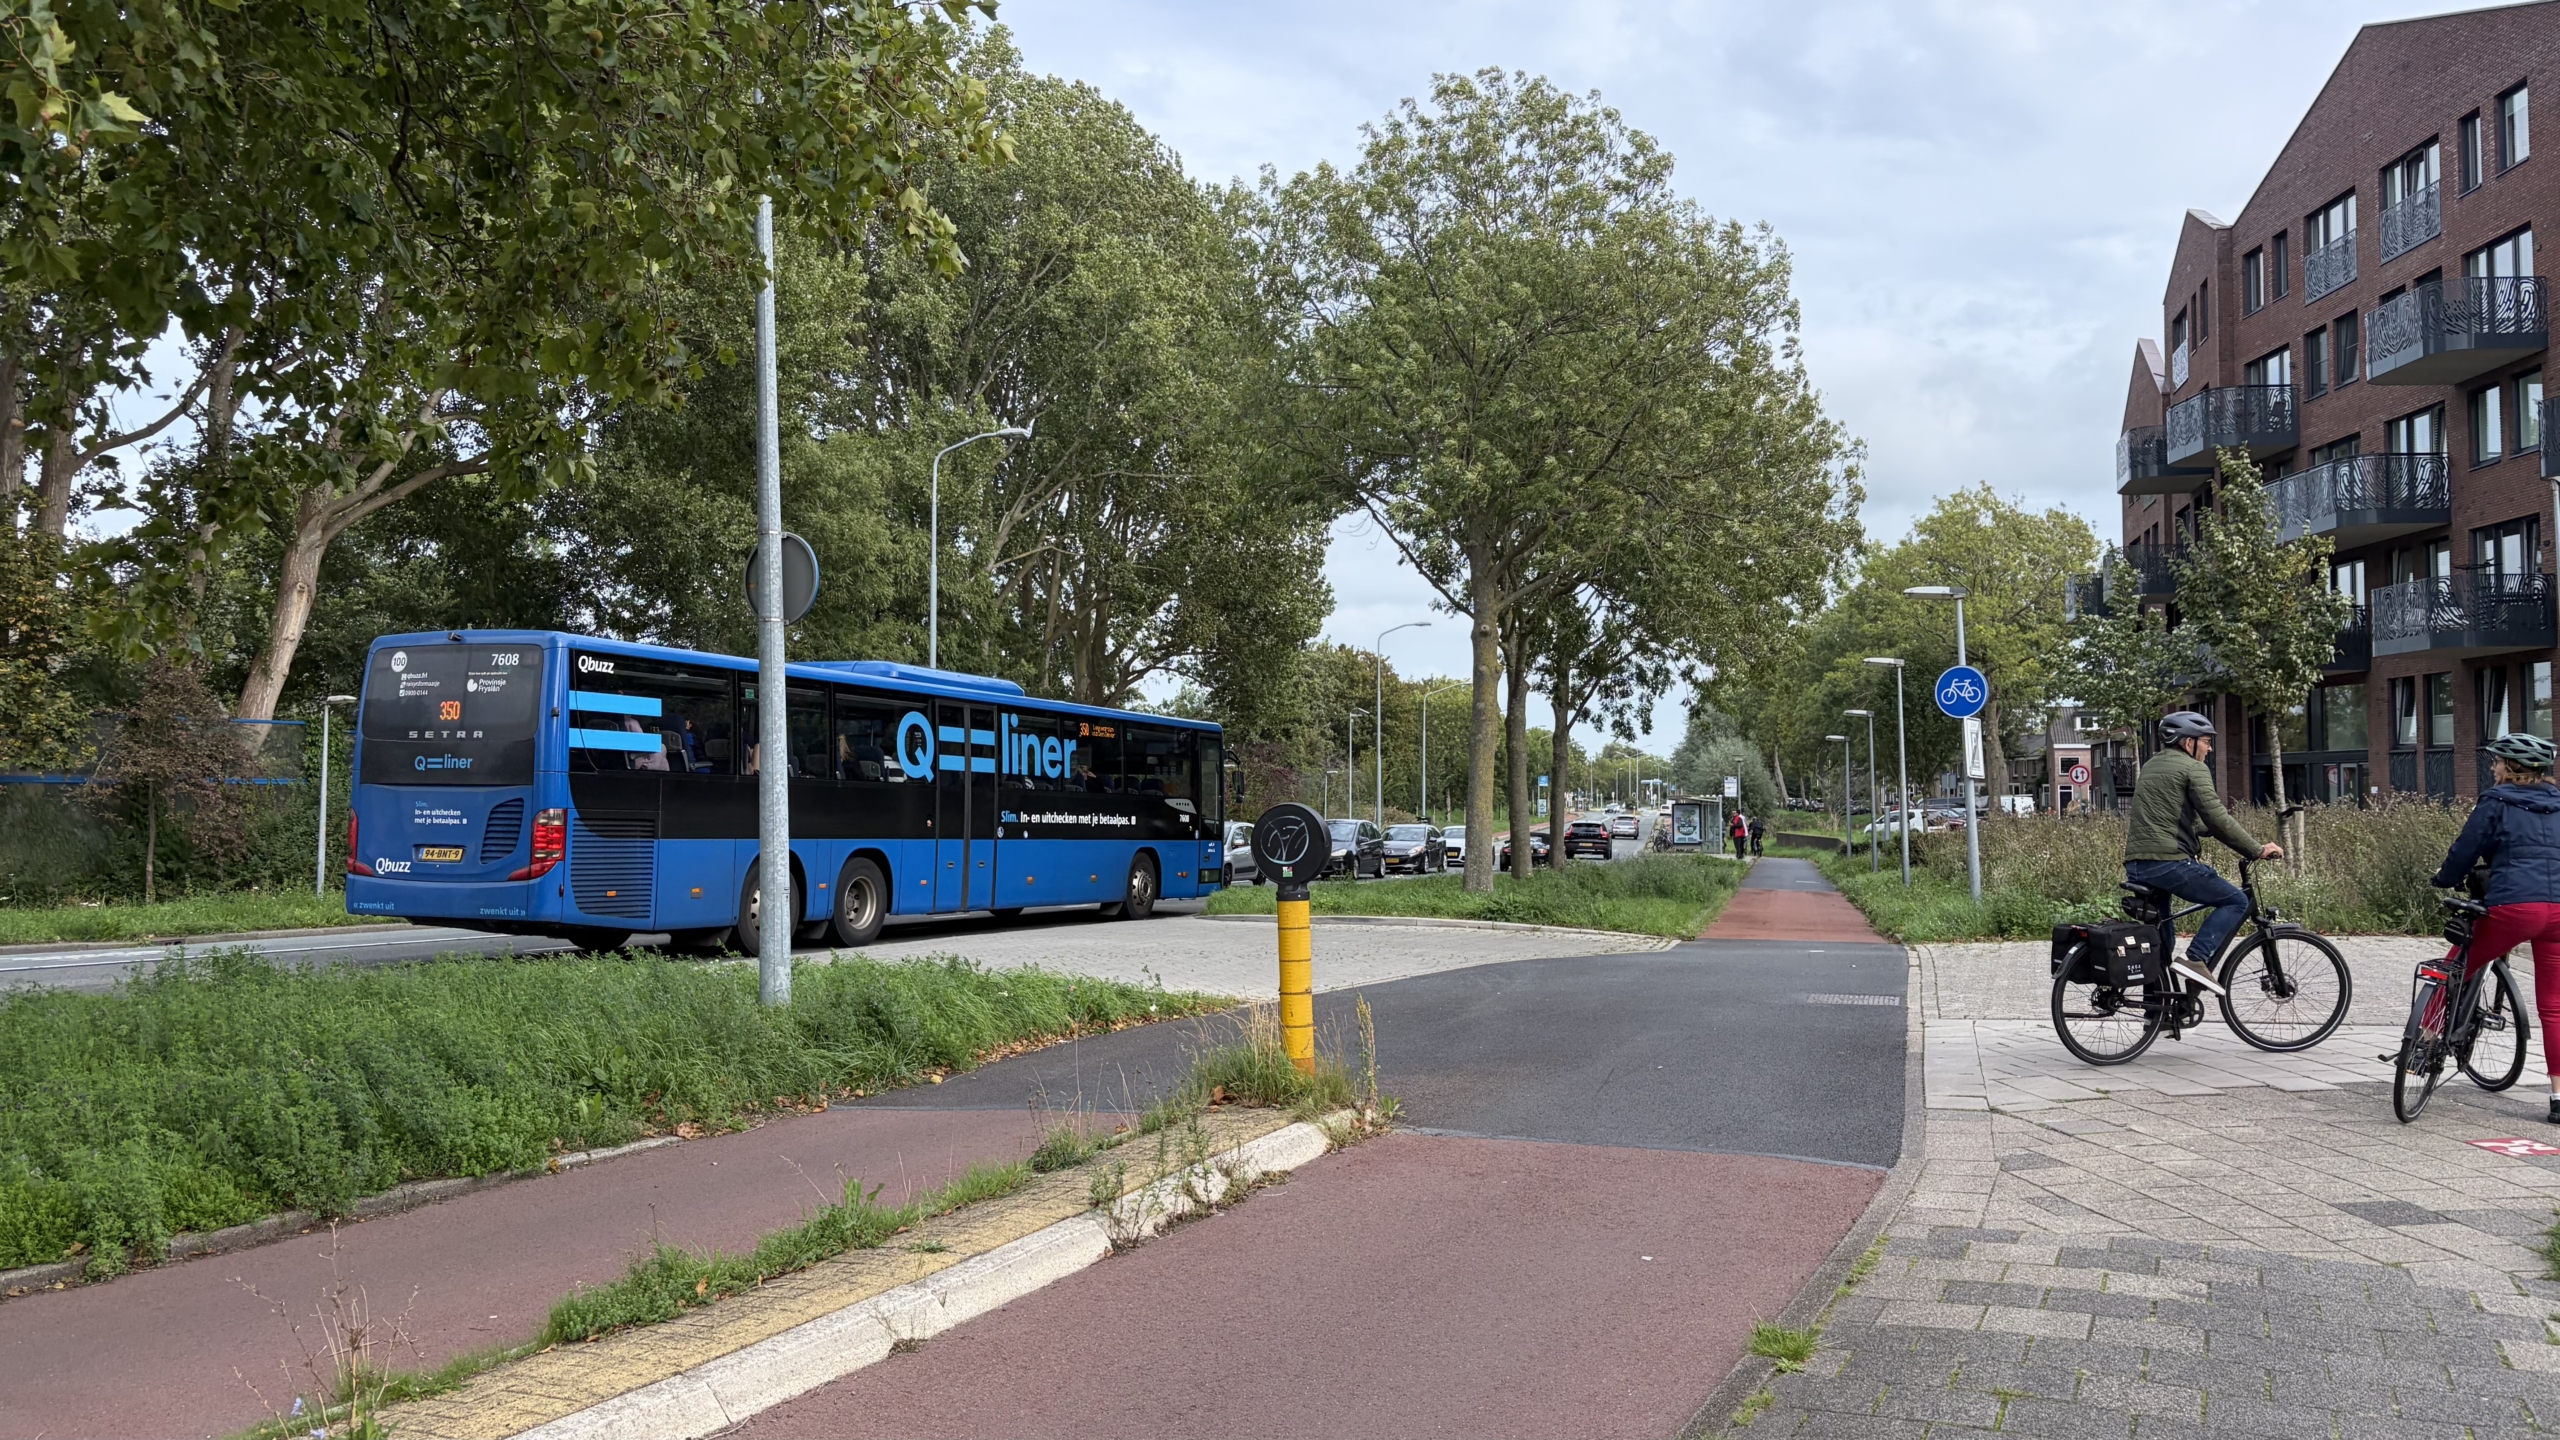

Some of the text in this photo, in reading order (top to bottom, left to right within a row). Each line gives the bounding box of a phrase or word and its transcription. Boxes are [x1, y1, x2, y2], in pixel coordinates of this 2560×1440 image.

[393, 657, 406, 667] 100
[491, 653, 520, 666] 7608
[578, 655, 614, 674] Qbuzz
[440, 701, 460, 720] 350
[426, 817, 432, 825] je
[1001, 810, 1130, 828] Slim. In- en uitchecken met je betaalpas.
[425, 849, 459, 859] 94-BNT-9
[375, 857, 411, 874] Qbuzz
[359, 901, 394, 910] zwenkt uit
[479, 907, 519, 916] zwenkt uit
